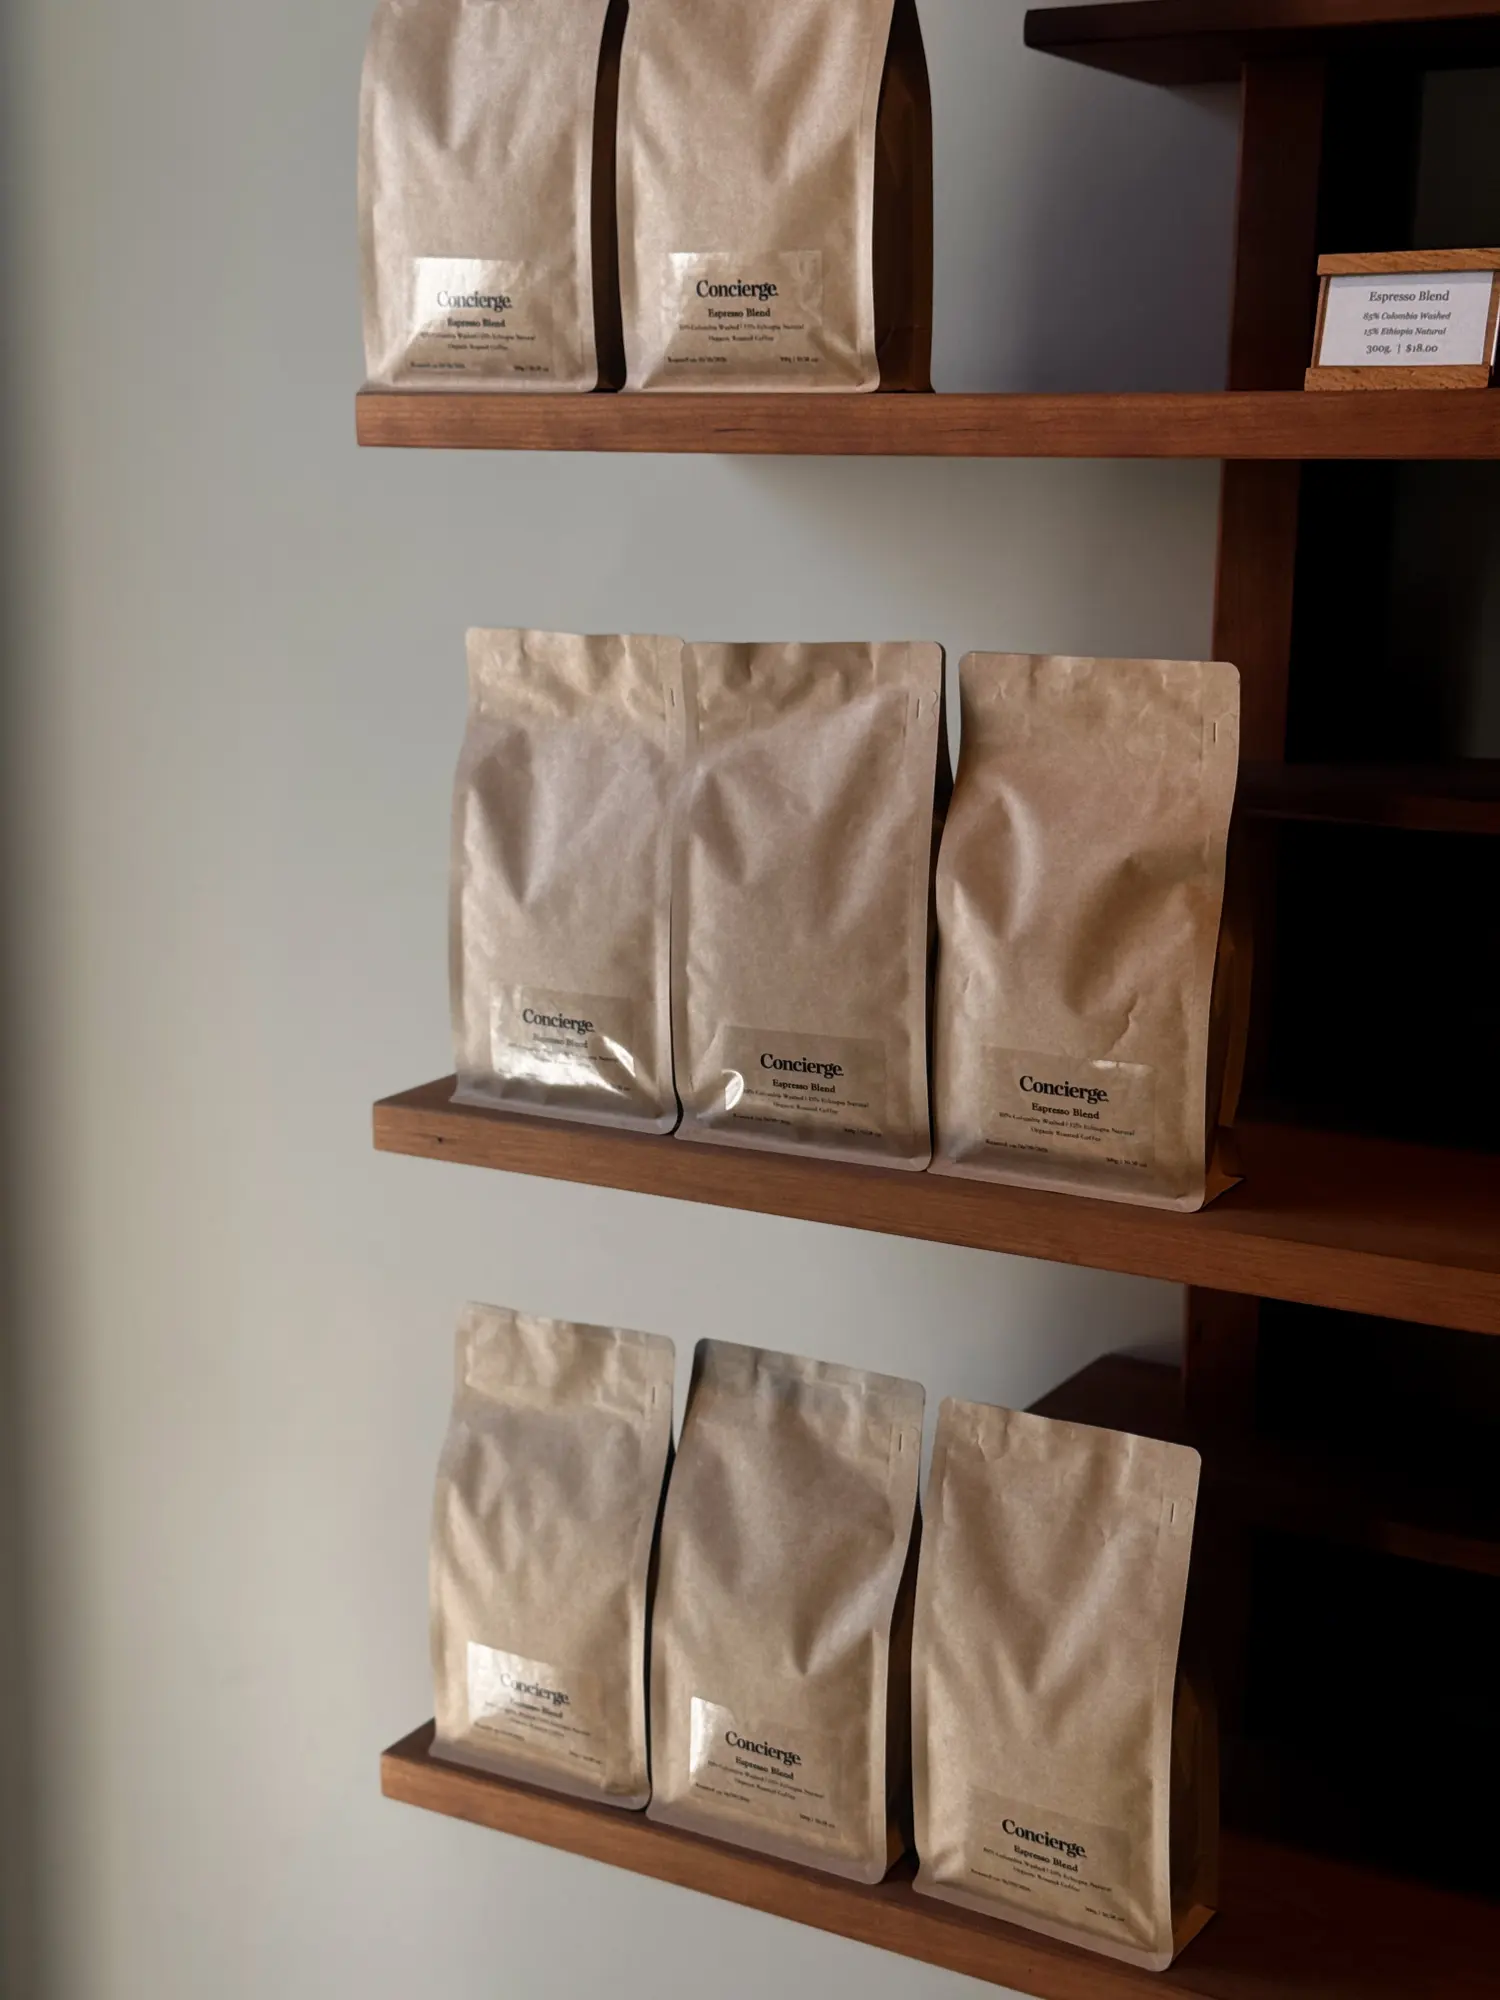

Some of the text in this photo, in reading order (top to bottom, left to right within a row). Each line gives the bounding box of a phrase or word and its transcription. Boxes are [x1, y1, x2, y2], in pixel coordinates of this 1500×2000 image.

[1369, 290, 1450, 304] Espresso Blend
[708, 308, 771, 319] Espresso Blend
[1362, 311, 1451, 322] 85% Colombia Washed
[1363, 327, 1447, 337] 15% Ethiopia Natural
[1405, 344, 1438, 353] $18.00
[772, 1078, 836, 1094] Espresso Blend
[1031, 1102, 1100, 1120] Espresso Blend
[735, 1756, 769, 1773] Espresso
[771, 1766, 794, 1780] Blend
[1013, 1844, 1050, 1863] Espresso
[1052, 1857, 1079, 1873] Blend
